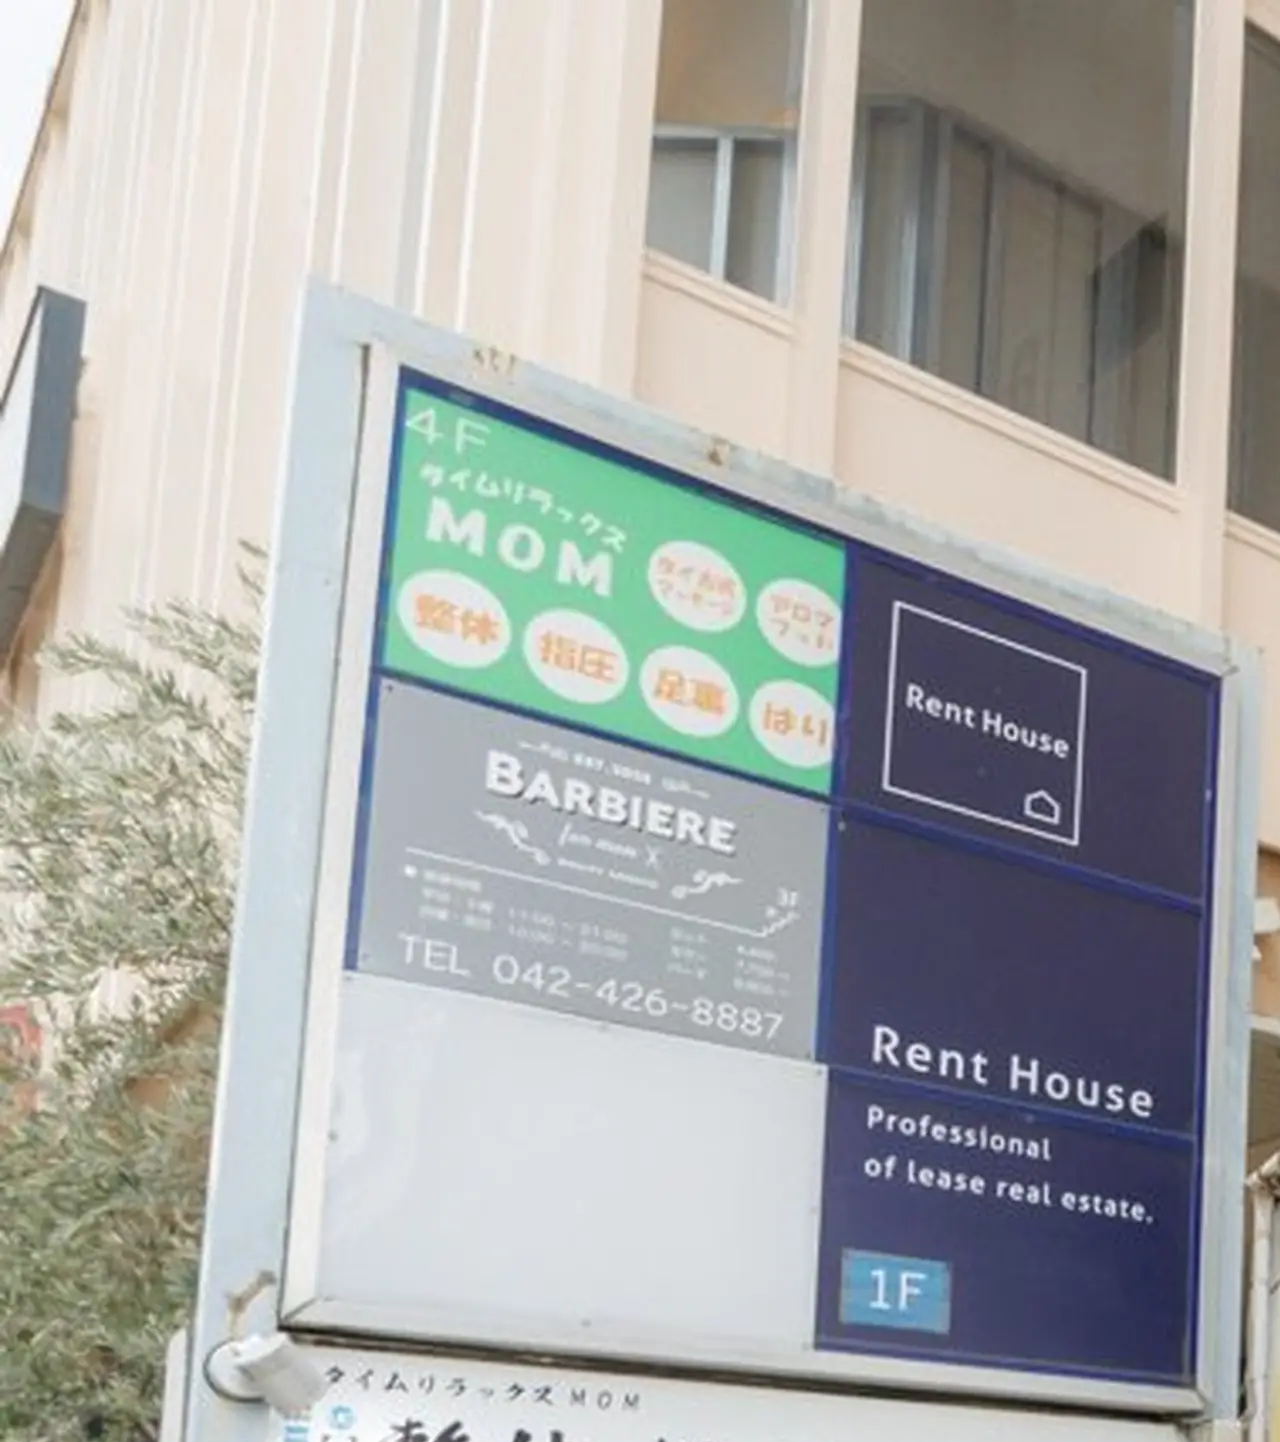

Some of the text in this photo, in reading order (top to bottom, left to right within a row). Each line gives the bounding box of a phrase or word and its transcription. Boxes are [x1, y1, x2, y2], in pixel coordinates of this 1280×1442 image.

[405, 407, 491, 455] 4F
[424, 497, 613, 597] MOM
[412, 593, 500, 646] 整体
[538, 629, 619, 683] 指圧
[762, 701, 828, 747] はり
[906, 682, 1070, 758] Rent House
[484, 748, 738, 856] BARBIERE
[398, 931, 472, 979] TEL
[491, 953, 784, 1041] 042-426-8887
[871, 1025, 1155, 1118] Rent House
[866, 1104, 1052, 1161] Professional
[864, 1155, 1155, 1224] of lease real estate.
[868, 1267, 929, 1311] 1F
